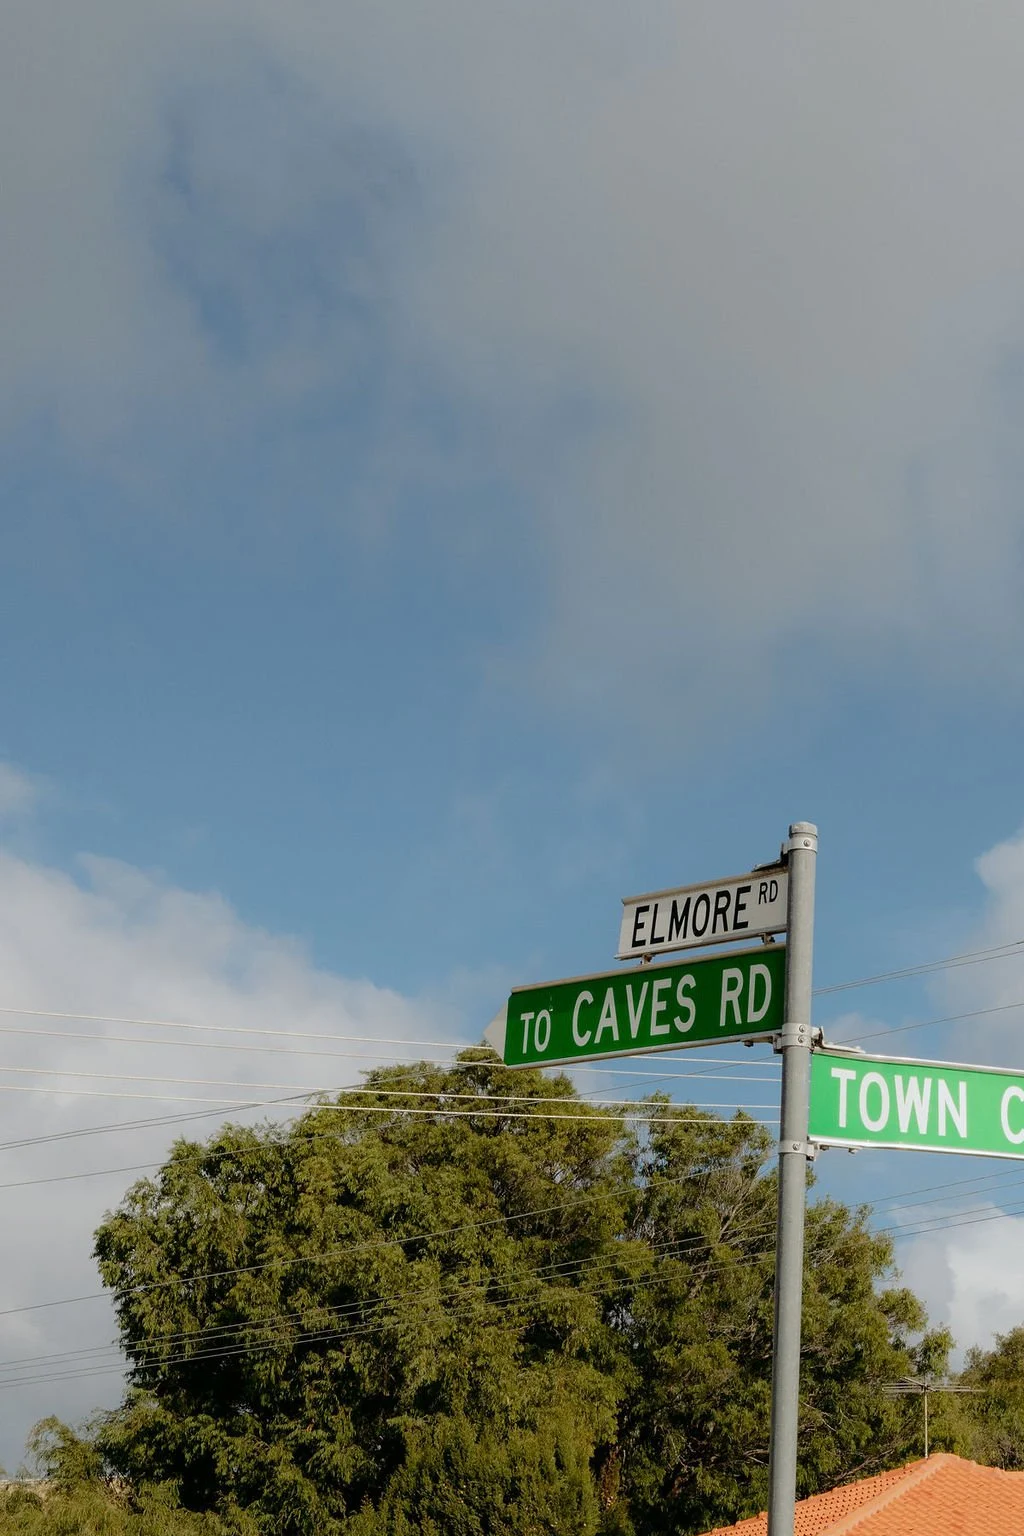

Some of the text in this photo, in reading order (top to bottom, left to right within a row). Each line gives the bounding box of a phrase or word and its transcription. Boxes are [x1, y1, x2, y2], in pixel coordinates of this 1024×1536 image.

[631, 879, 779, 949] ELMORE RD
[520, 962, 773, 1054] TO CAVES RD
[830, 1067, 968, 1139] TOWN
